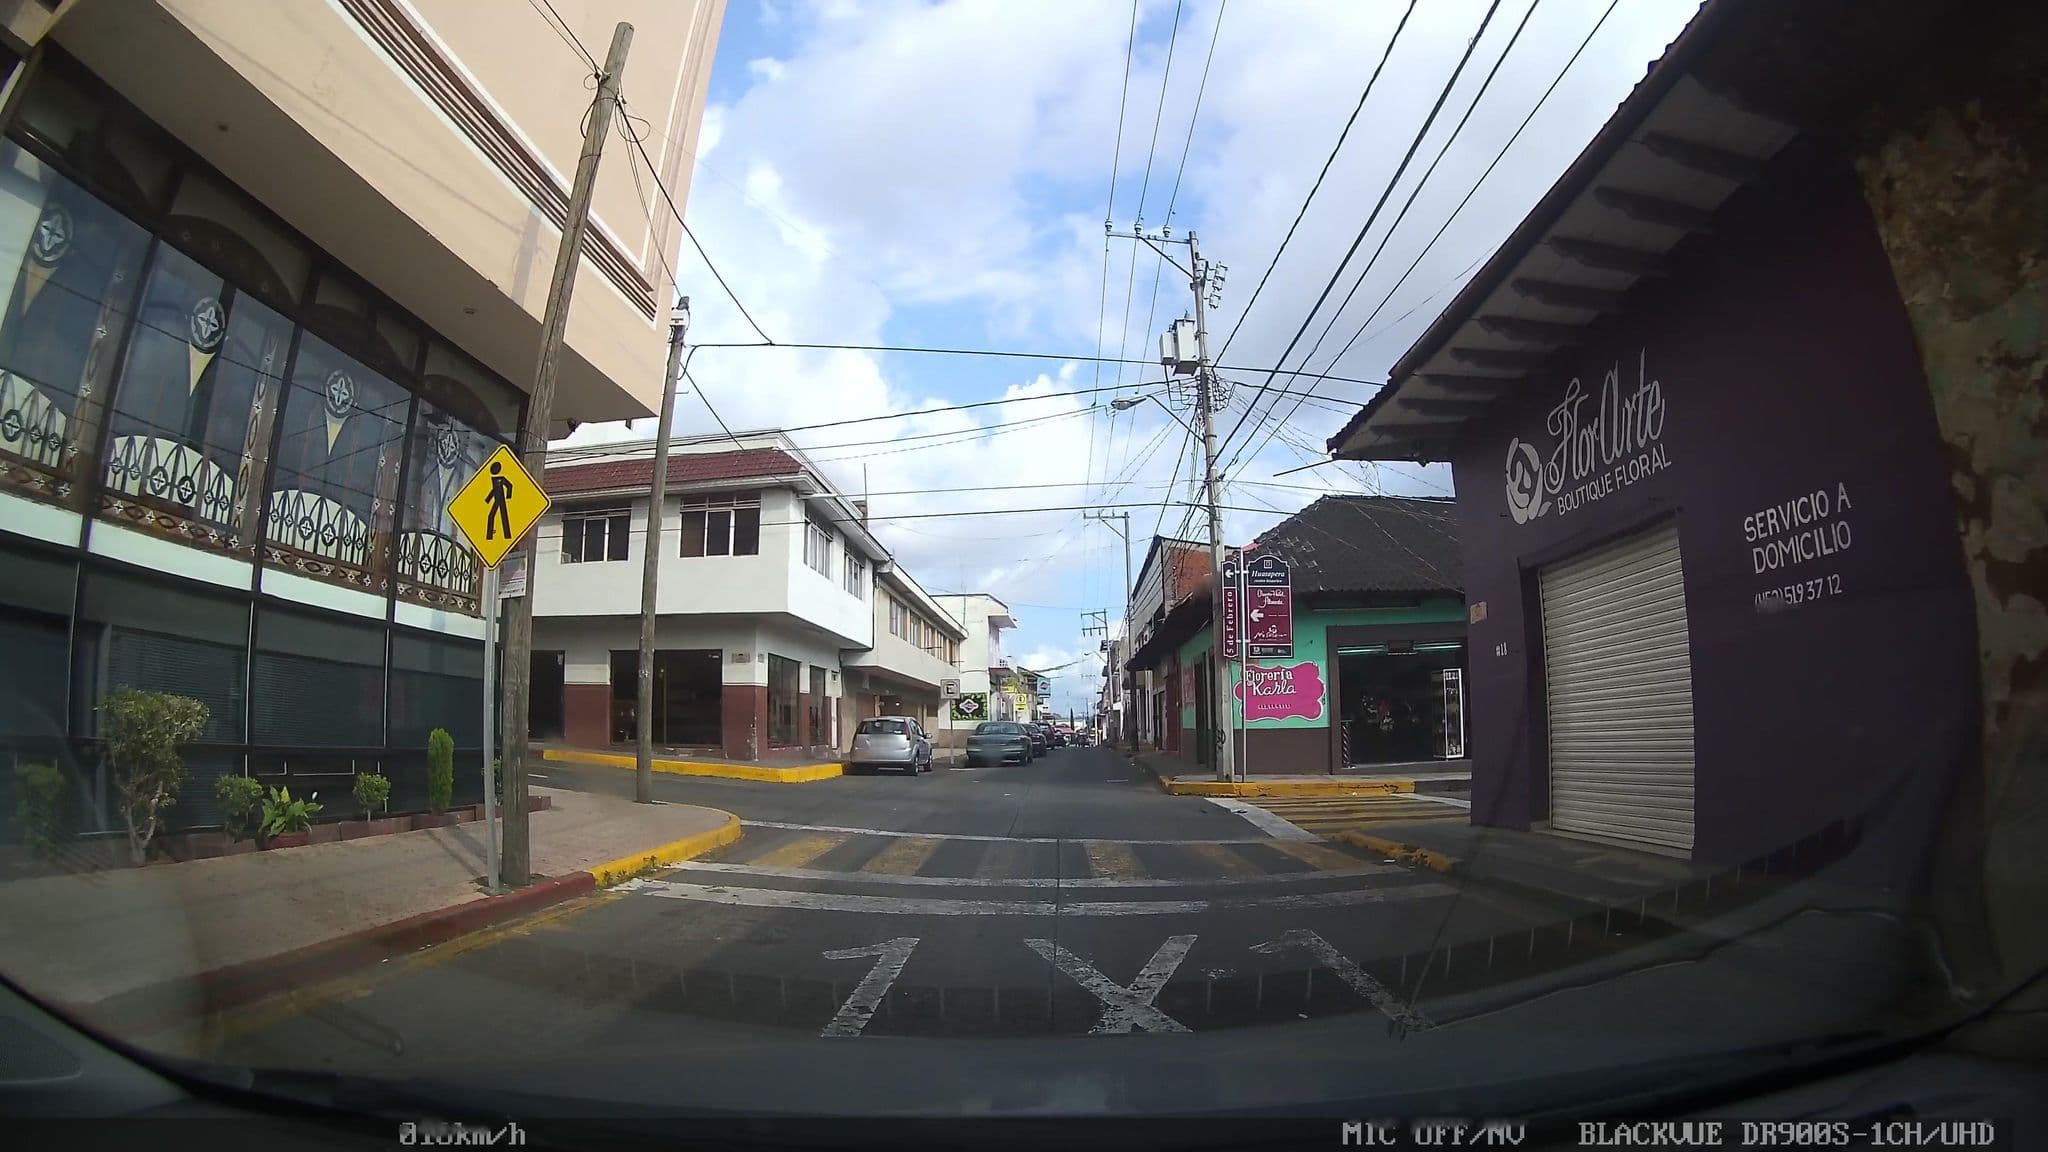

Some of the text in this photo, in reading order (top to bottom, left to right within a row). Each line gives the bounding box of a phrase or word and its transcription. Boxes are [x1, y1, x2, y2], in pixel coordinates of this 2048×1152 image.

[1557, 443, 1671, 516] BOUTIQUE FLORAL
[1744, 482, 1852, 542] SERVICIO A
[1752, 520, 1852, 574] DOMICILIO
[1806, 578, 1823, 601] 37
[1827, 573, 1842, 595] 12
[1226, 591, 1235, 632] Febrero
[1226, 634, 1235, 647] de
[1252, 679, 1297, 696] Karla
